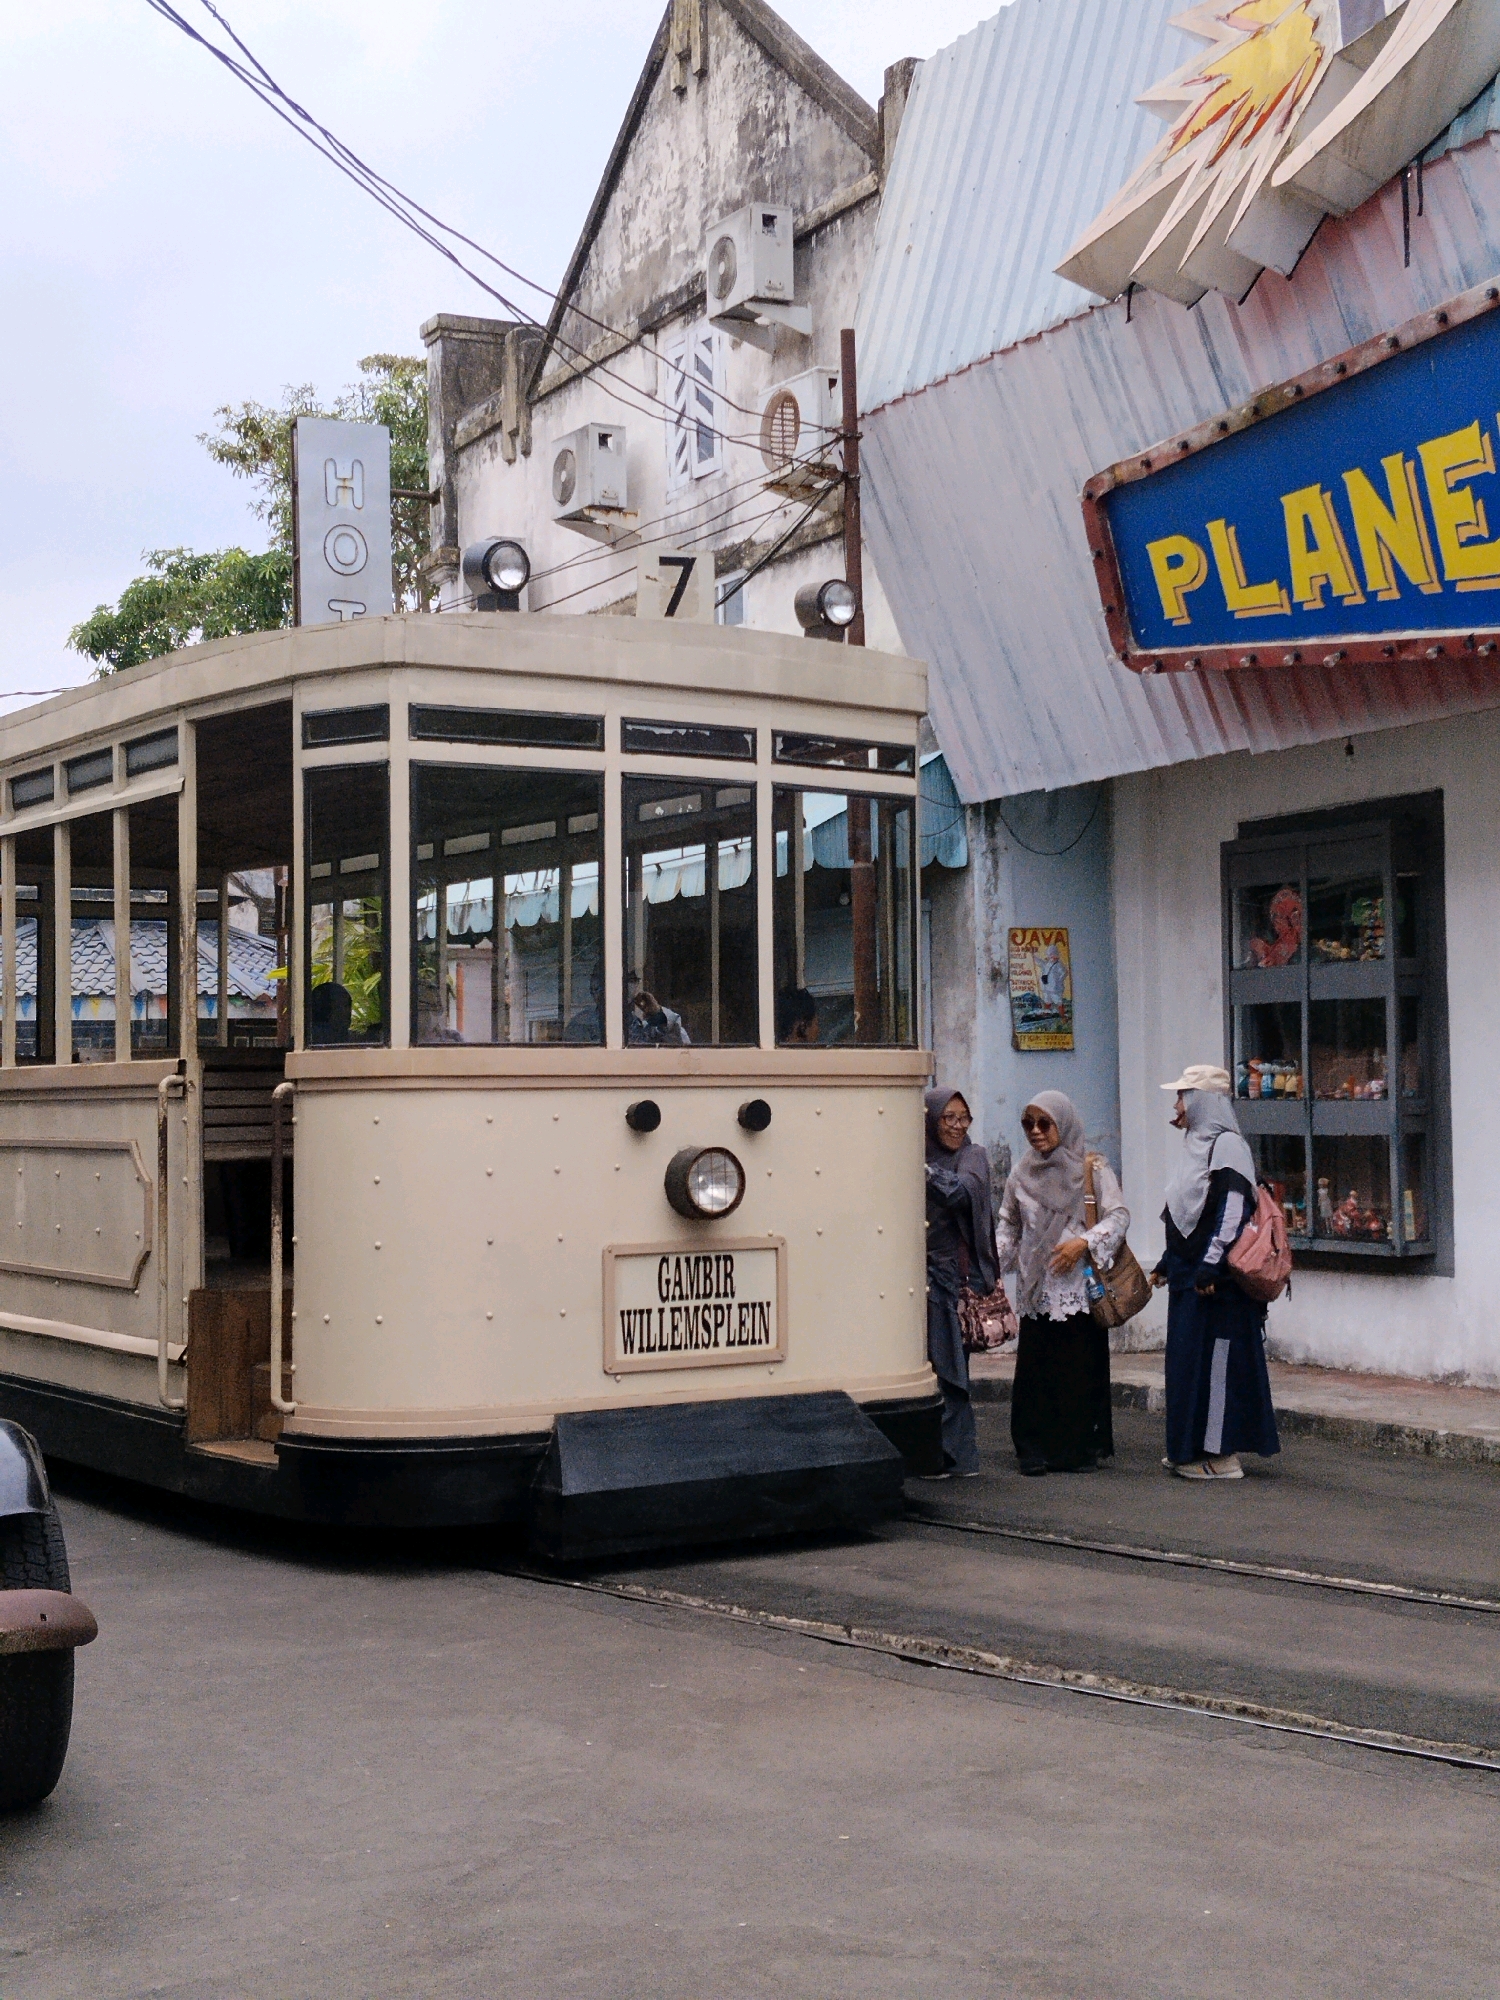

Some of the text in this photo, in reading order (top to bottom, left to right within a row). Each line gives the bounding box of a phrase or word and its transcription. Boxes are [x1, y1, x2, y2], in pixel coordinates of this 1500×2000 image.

[1145, 412, 1500, 627] PLANE
[658, 555, 698, 618] 7
[1010, 930, 1067, 947] JAVA
[657, 1254, 736, 1304] GAMBIR
[619, 1301, 771, 1355] WILLEMSPLEIN
